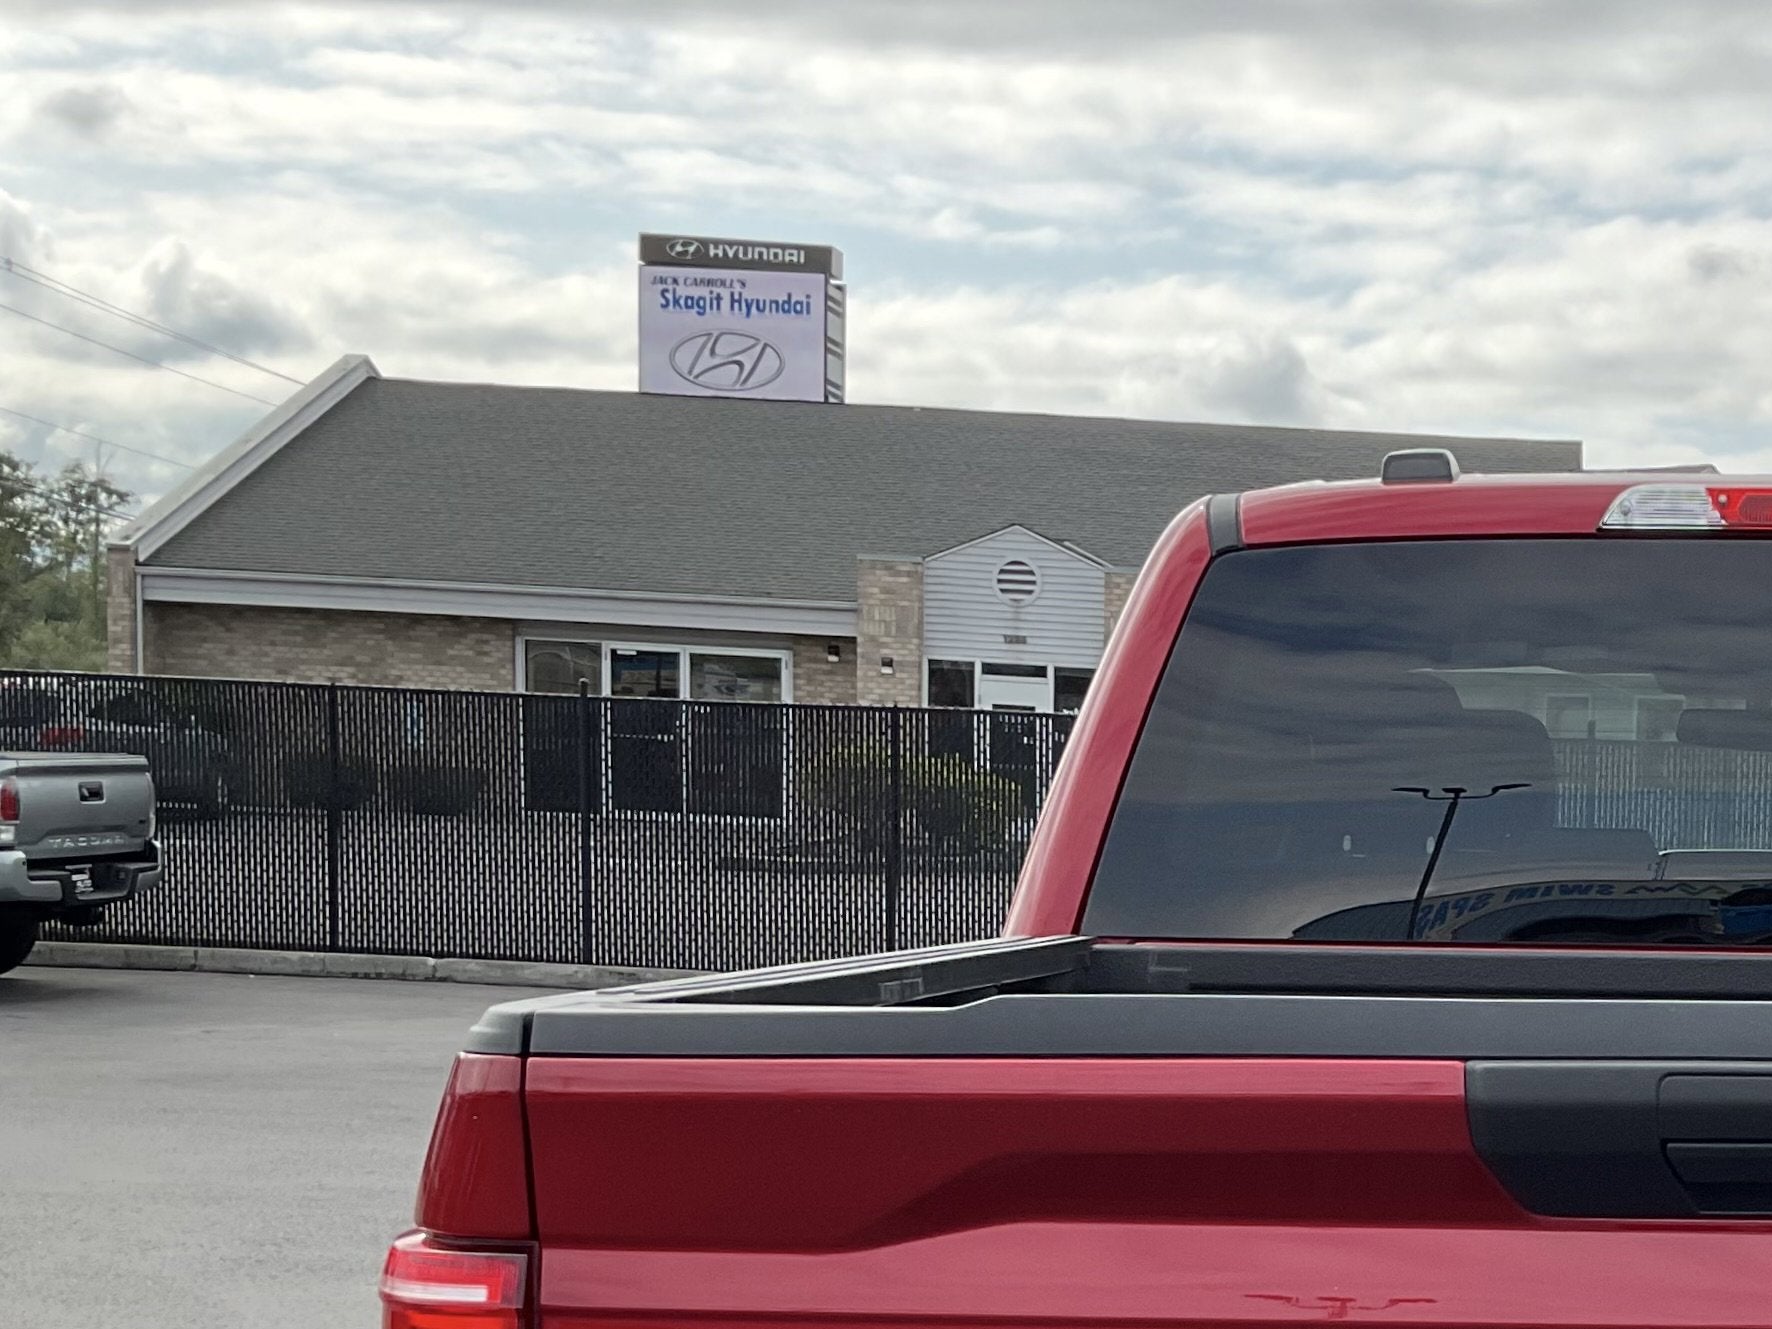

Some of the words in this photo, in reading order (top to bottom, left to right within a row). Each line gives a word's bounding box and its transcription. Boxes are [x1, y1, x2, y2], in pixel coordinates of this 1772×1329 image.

[709, 244, 806, 265] HYUNDAI
[651, 275, 679, 287] JACK
[683, 277, 747, 289] CARROLL'S
[660, 288, 723, 316] Skagit
[730, 291, 812, 318] Hyundai
[48, 836, 124, 848] TACOMA
